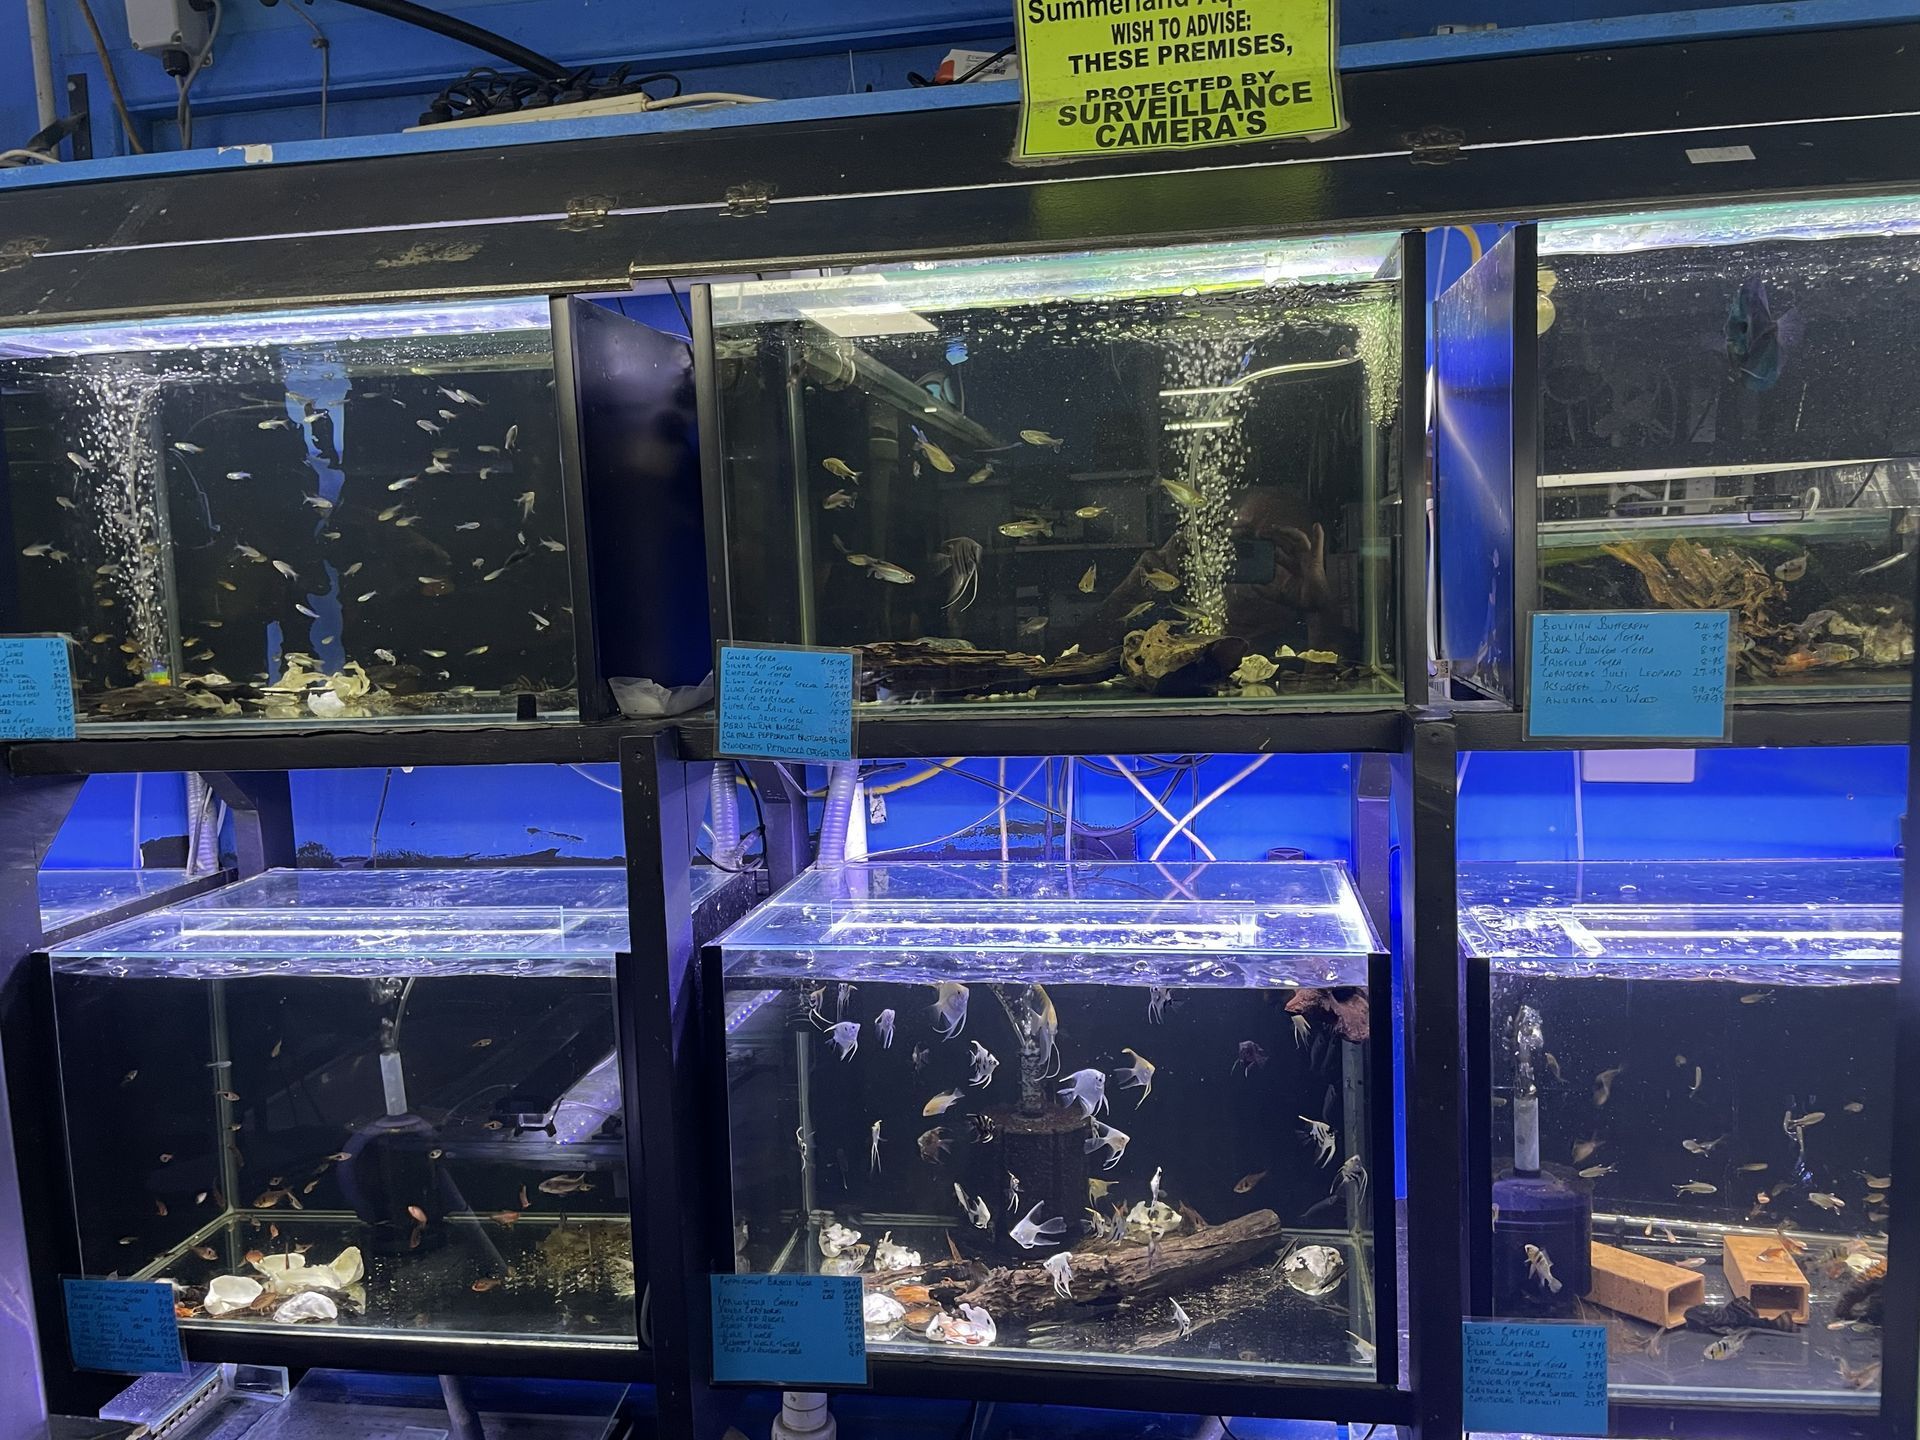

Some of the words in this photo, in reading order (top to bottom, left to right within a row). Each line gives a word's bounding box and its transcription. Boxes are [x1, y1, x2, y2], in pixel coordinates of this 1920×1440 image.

[1111, 20, 1154, 45] WISH
[1159, 17, 1181, 40] TO
[1186, 10, 1251, 37] ADVISE:
[1068, 47, 1149, 75] THESE
[1158, 33, 1293, 65] PREMISES,
[1058, 81, 1313, 127] SURVEILLANCE
[1085, 75, 1233, 102] PROTECTED
[1241, 70, 1276, 86] BY
[1095, 110, 1267, 148] CAMERA'S
